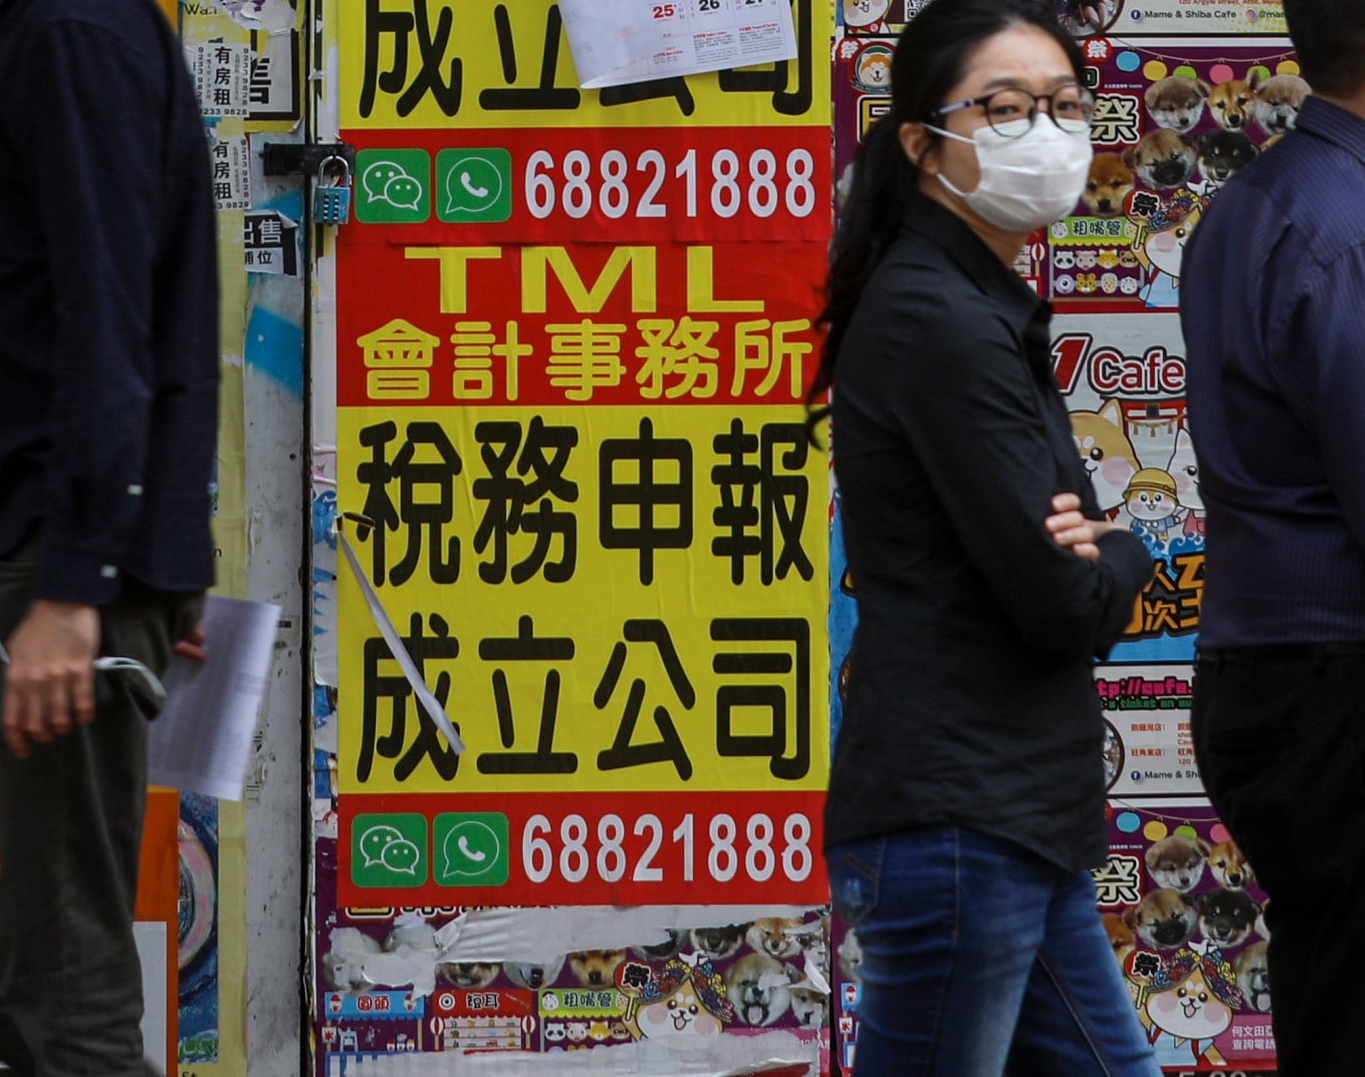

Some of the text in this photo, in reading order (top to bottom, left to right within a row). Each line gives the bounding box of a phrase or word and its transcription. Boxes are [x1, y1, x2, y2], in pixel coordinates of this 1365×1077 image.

[214, 46, 231, 106] 有房租
[524, 148, 815, 218] 68821888
[404, 247, 765, 314] TML
[356, 318, 813, 401] 會計事務所
[356, 415, 814, 587] 稅務申報
[356, 612, 811, 782] 成立公司
[522, 813, 813, 883] 68821888
